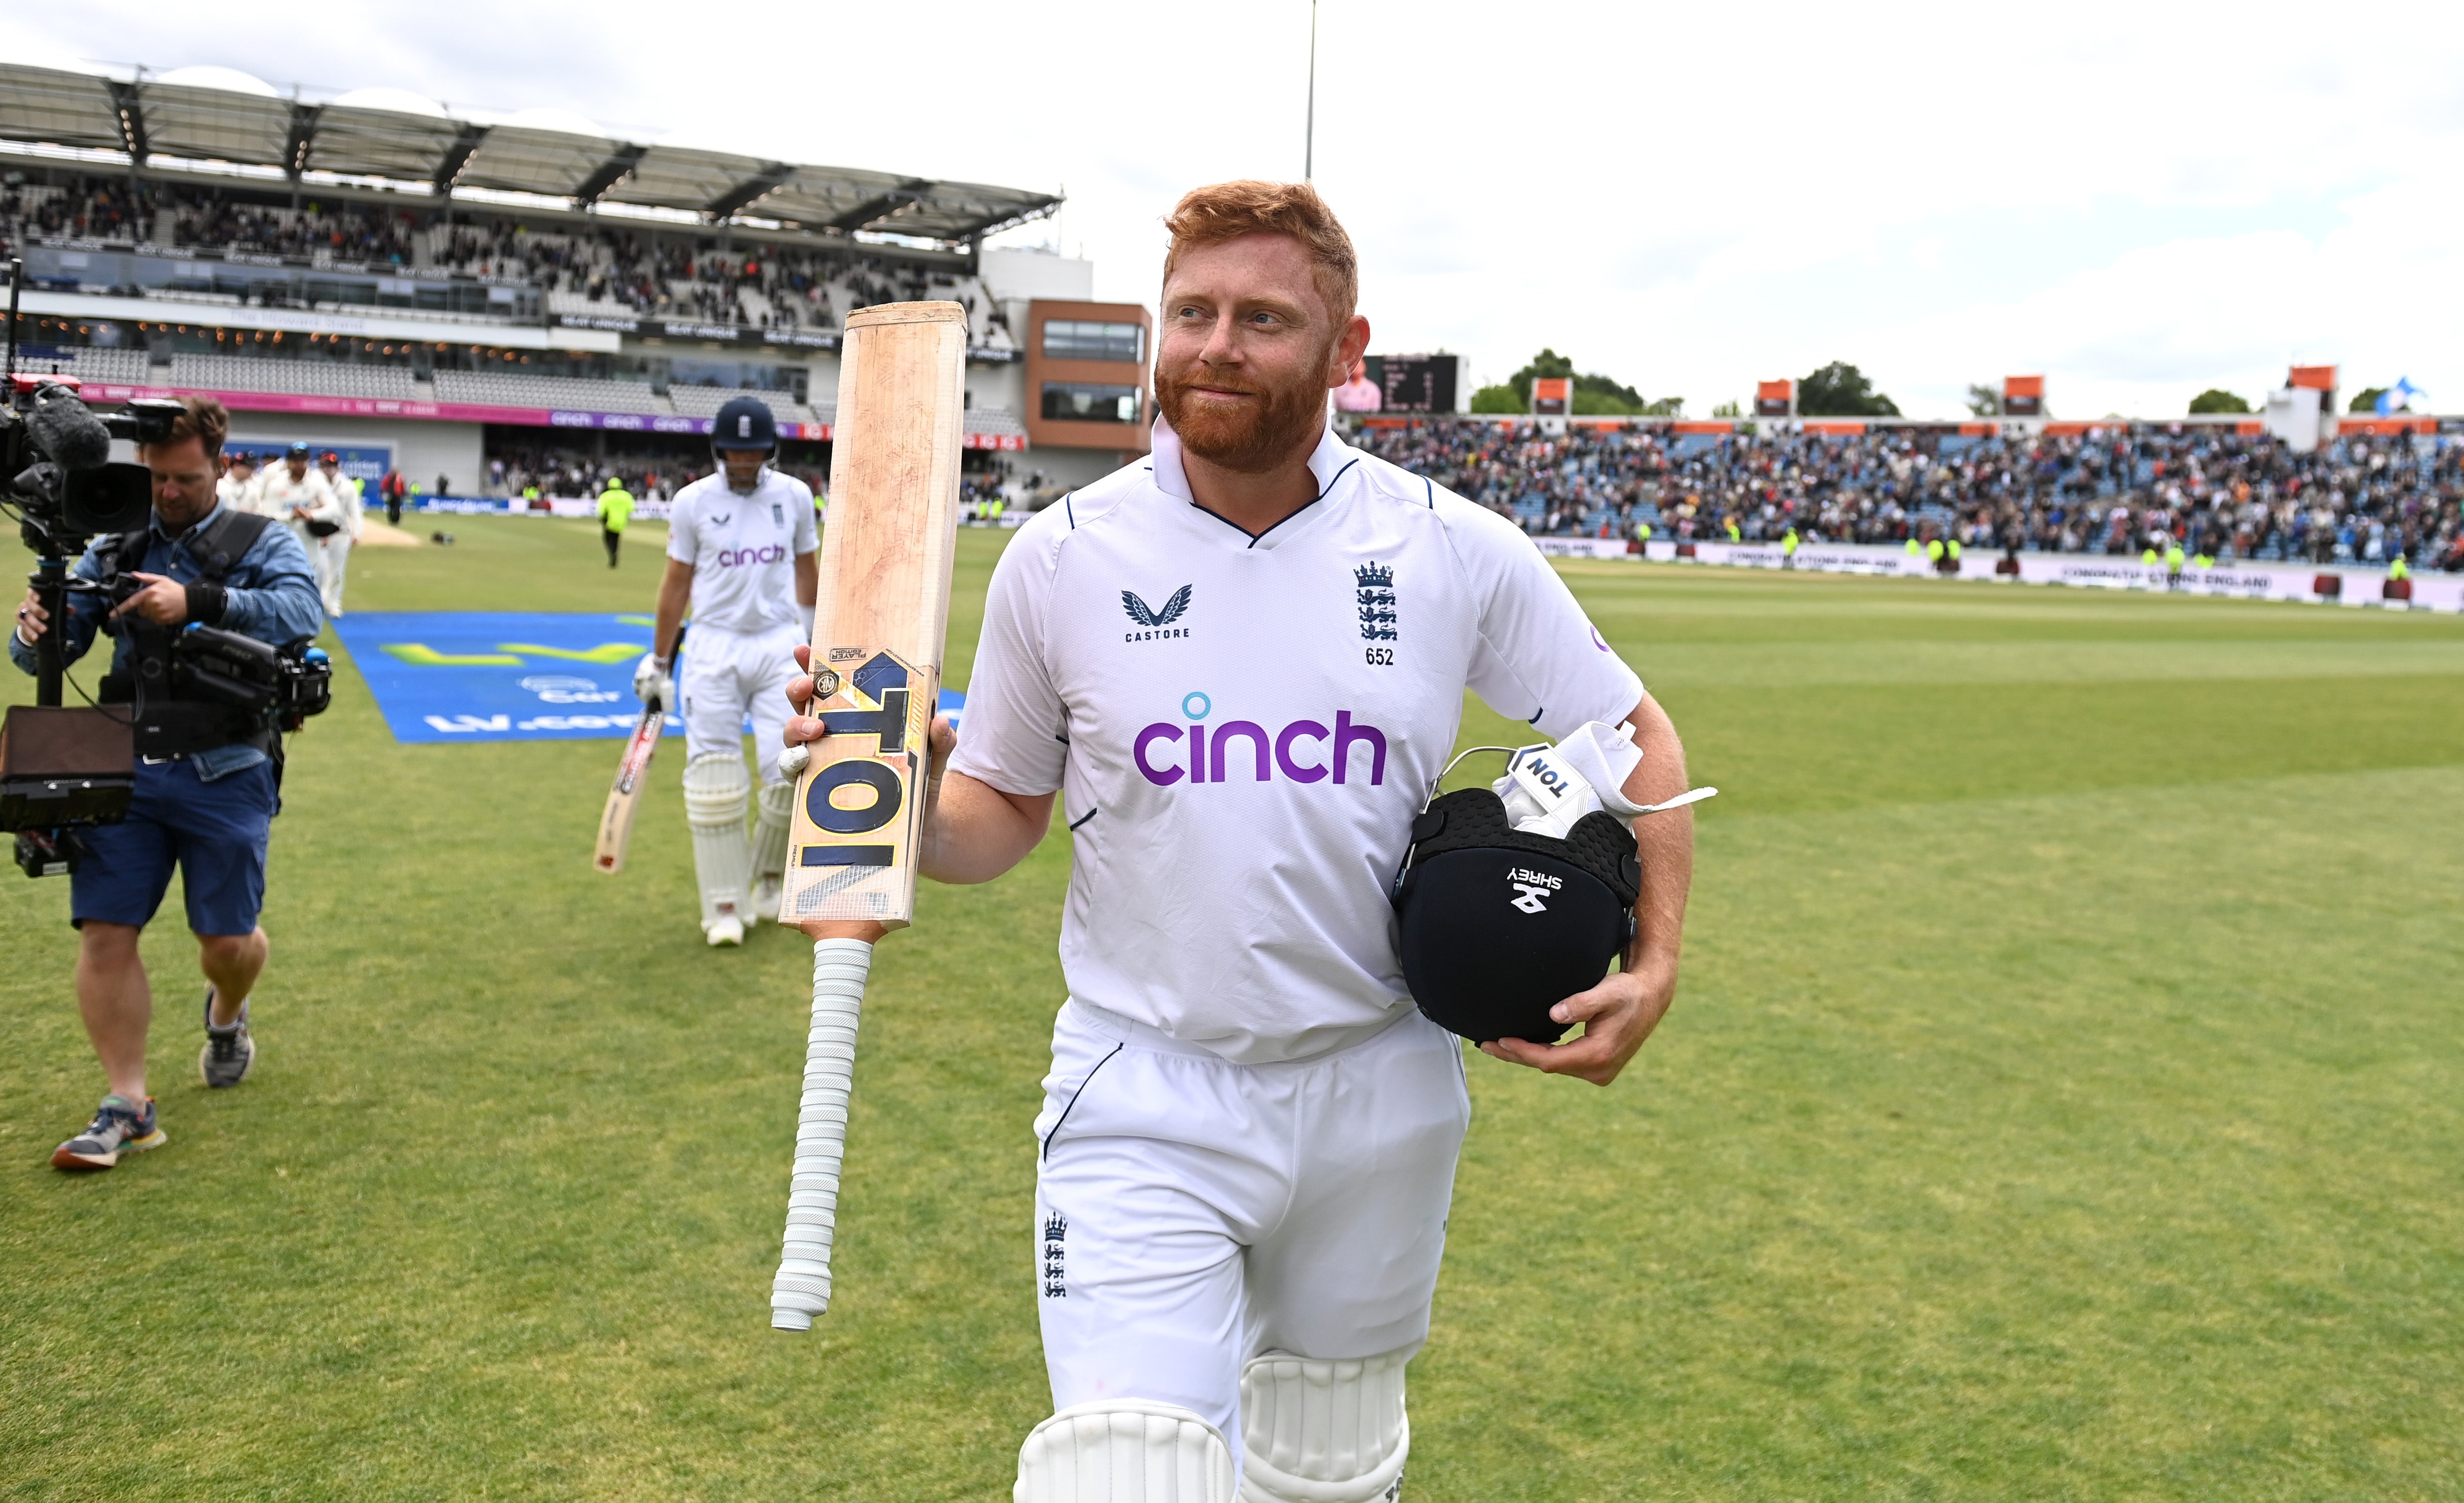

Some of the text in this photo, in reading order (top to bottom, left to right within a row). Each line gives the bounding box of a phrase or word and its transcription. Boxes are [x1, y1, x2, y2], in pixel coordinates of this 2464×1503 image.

[718, 540, 786, 568] cinch
[1125, 628, 1190, 643] CASTORE
[1365, 647, 1393, 666] 652
[1133, 691, 1387, 786] cinch
[1526, 757, 1569, 799] TON
[796, 687, 912, 915] TON
[1507, 867, 1563, 891] SHREY
